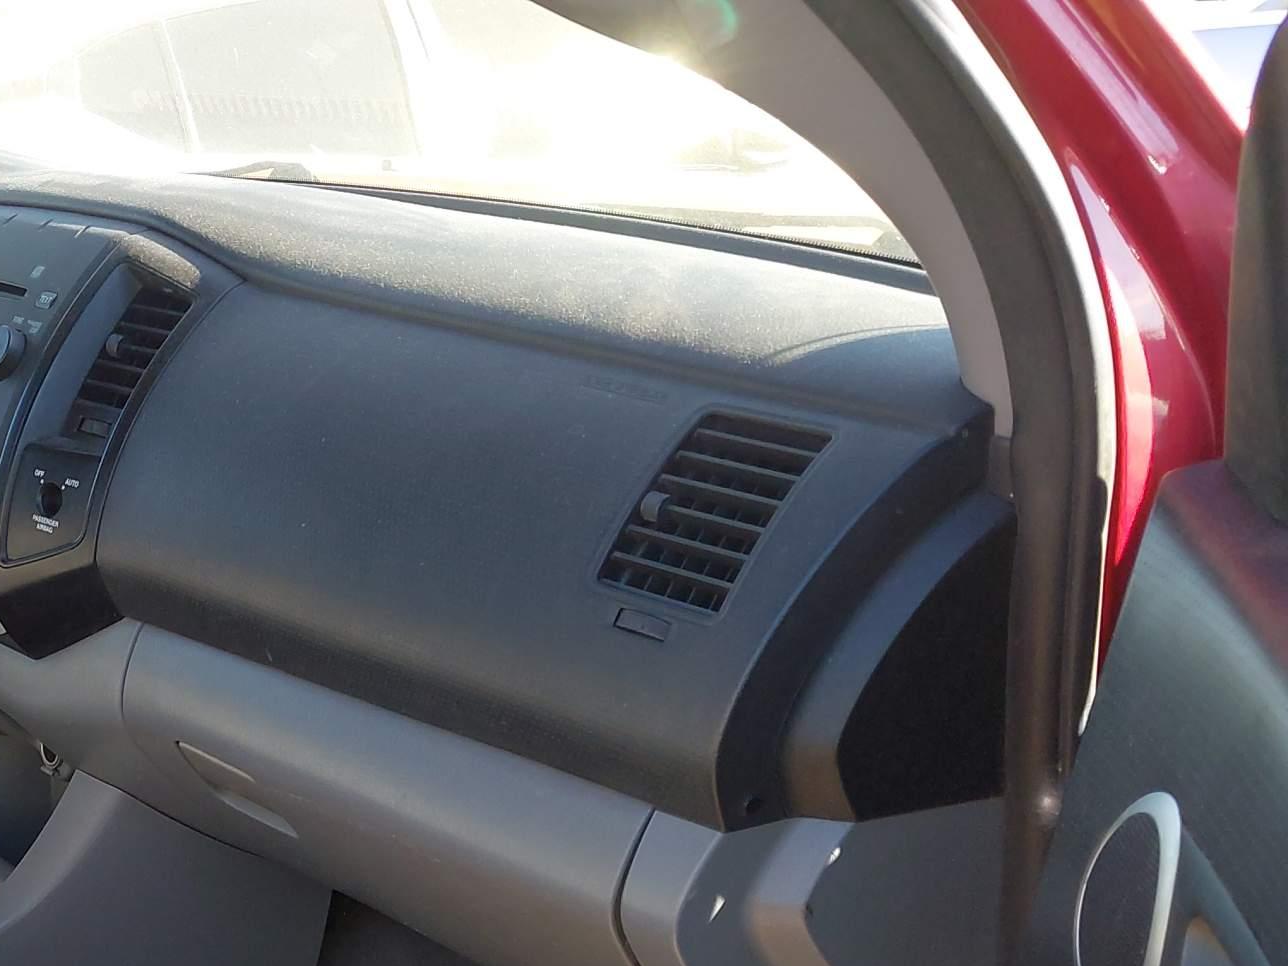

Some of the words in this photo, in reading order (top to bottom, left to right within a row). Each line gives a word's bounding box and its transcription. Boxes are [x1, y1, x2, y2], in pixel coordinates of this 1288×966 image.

[34, 468, 45, 477] OFF
[64, 477, 80, 489] AUTO
[31, 513, 59, 528] PASSENGER
